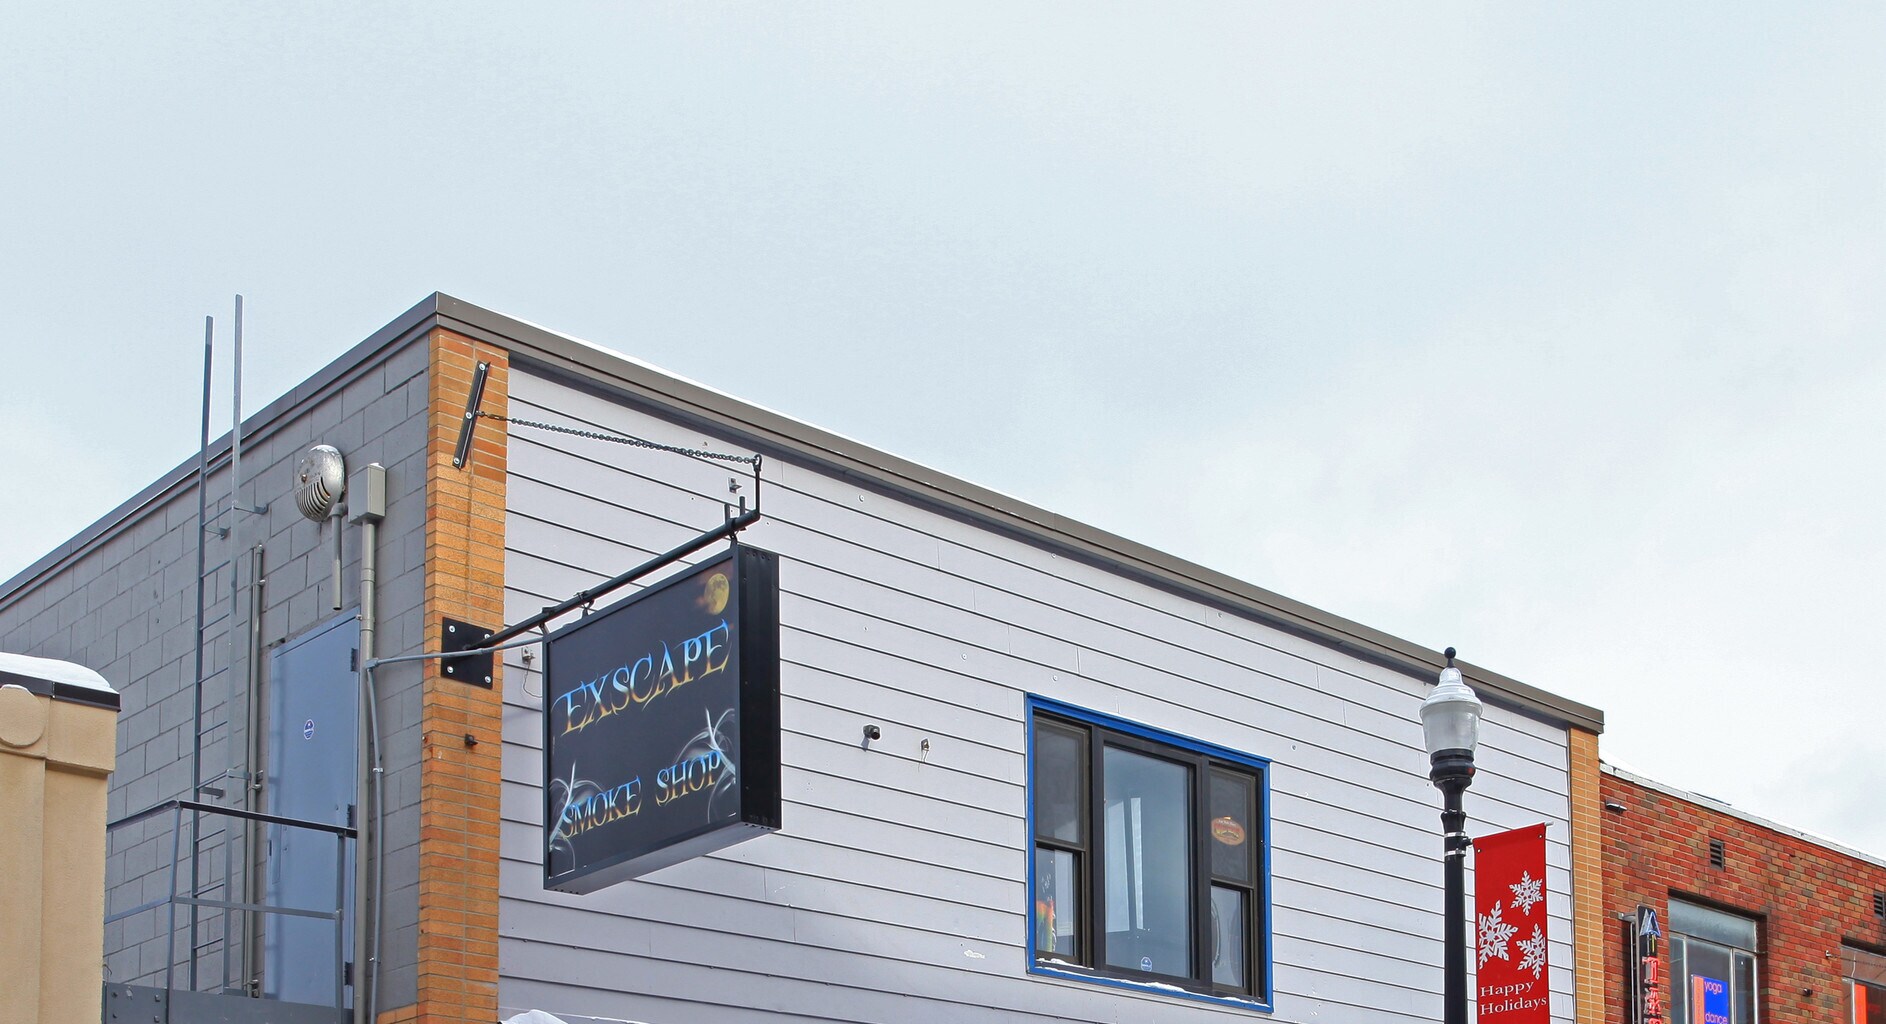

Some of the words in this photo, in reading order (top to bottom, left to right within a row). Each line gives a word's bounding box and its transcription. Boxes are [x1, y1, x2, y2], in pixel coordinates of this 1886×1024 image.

[551, 619, 730, 737] EXSCAPE
[560, 776, 642, 840] SMOKE
[656, 751, 722, 807] SHOP
[1480, 979, 1534, 998] Happy
[1704, 981, 1722, 995] yoga
[1480, 994, 1547, 1016] Holidays
